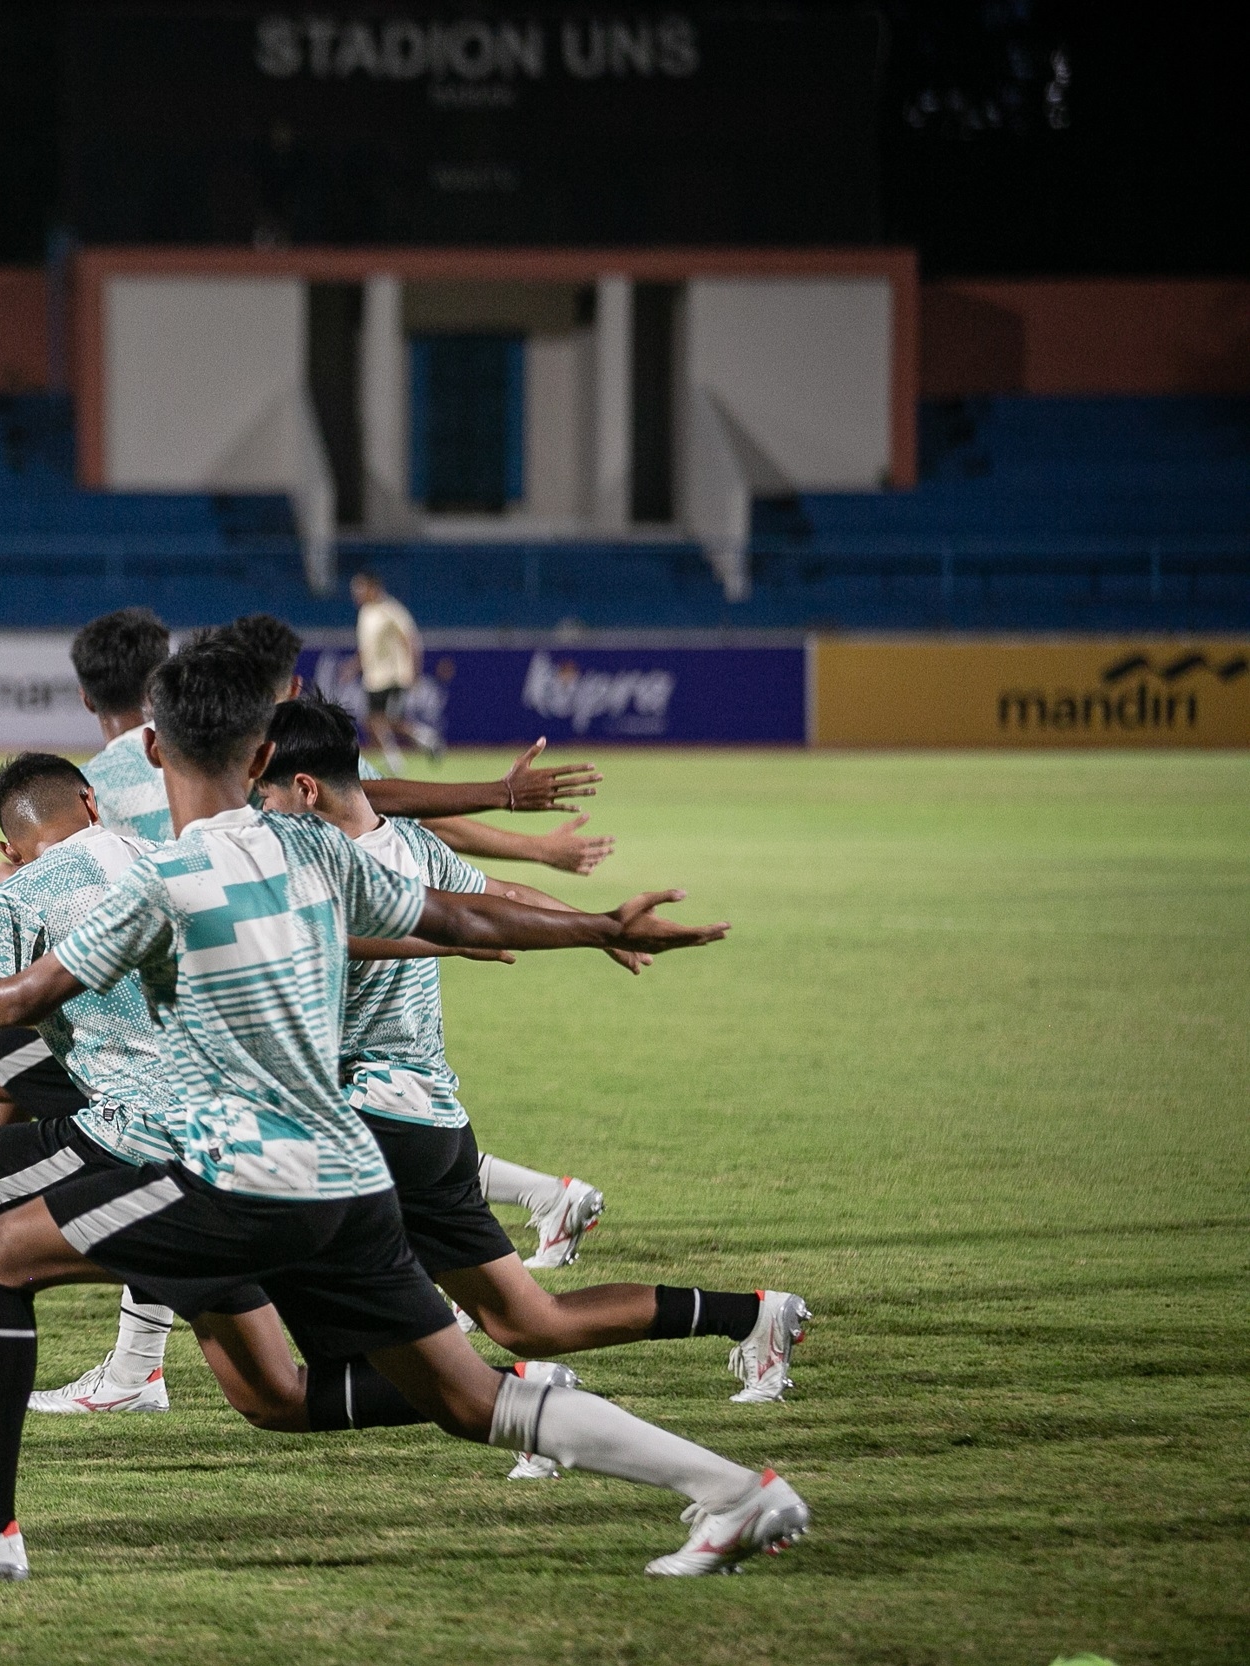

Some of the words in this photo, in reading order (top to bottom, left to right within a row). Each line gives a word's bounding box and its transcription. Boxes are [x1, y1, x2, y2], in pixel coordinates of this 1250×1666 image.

[256, 15, 544, 79] STADION
[561, 15, 701, 79] UNS
[996, 682, 1197, 728] mandiri
